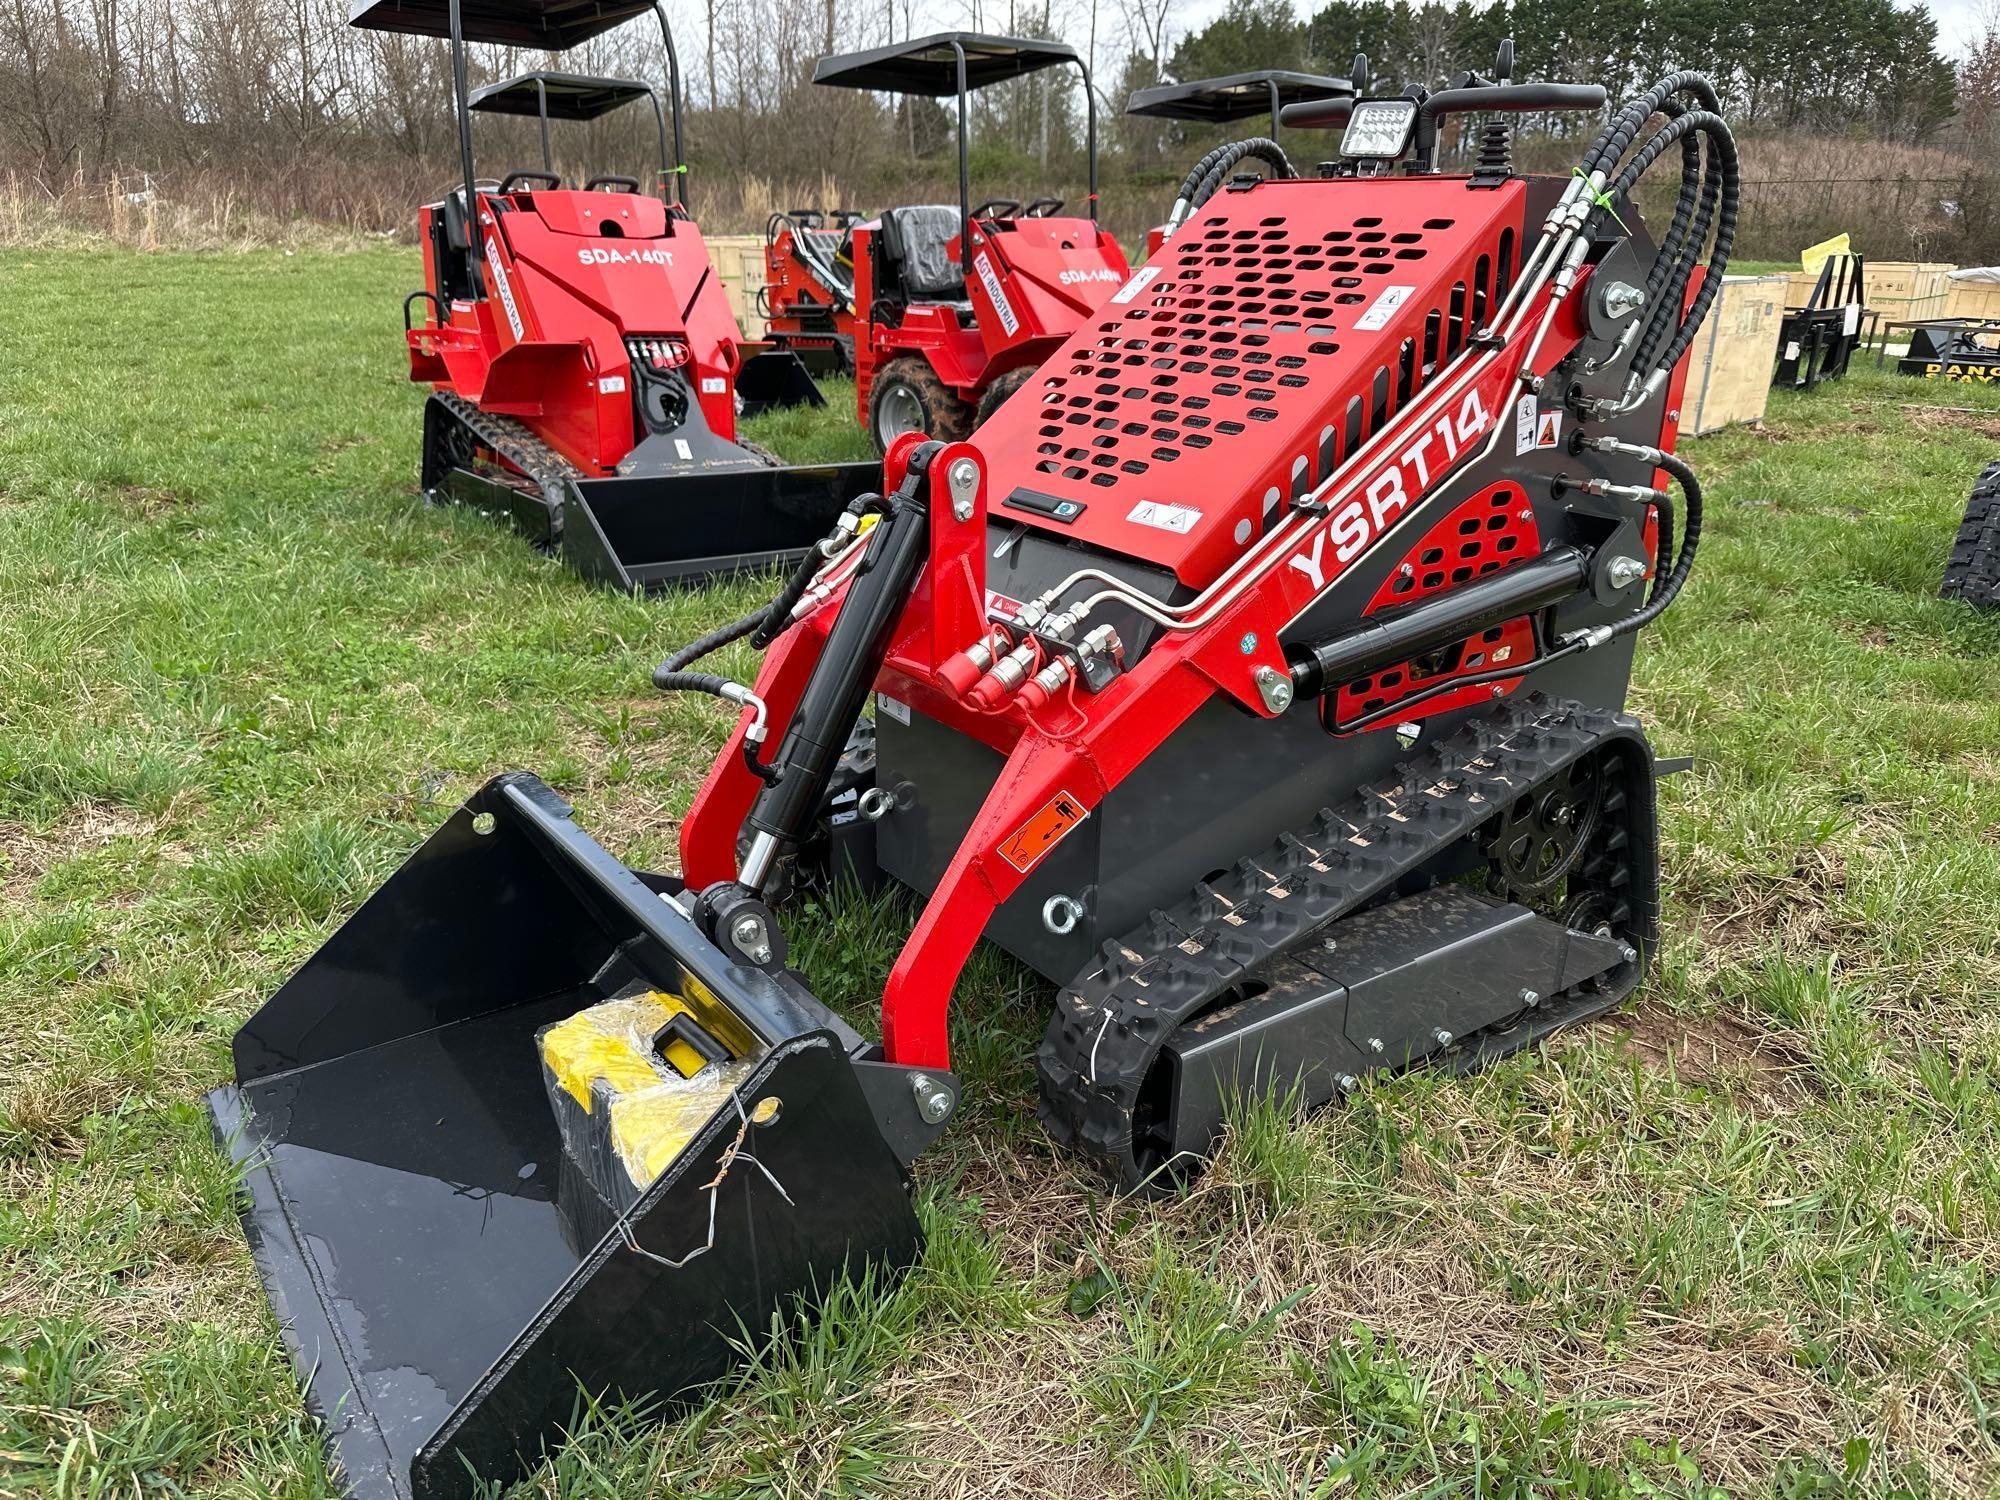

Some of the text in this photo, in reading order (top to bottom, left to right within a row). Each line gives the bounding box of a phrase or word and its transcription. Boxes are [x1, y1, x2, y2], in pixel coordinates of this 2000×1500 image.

[487, 242, 521, 338] AGT-INDUSTRIAL
[577, 248, 673, 266] SDA-140T
[976, 256, 1016, 333] AGT-INDUSTRIAL
[1288, 387, 1490, 590] YSRT14
